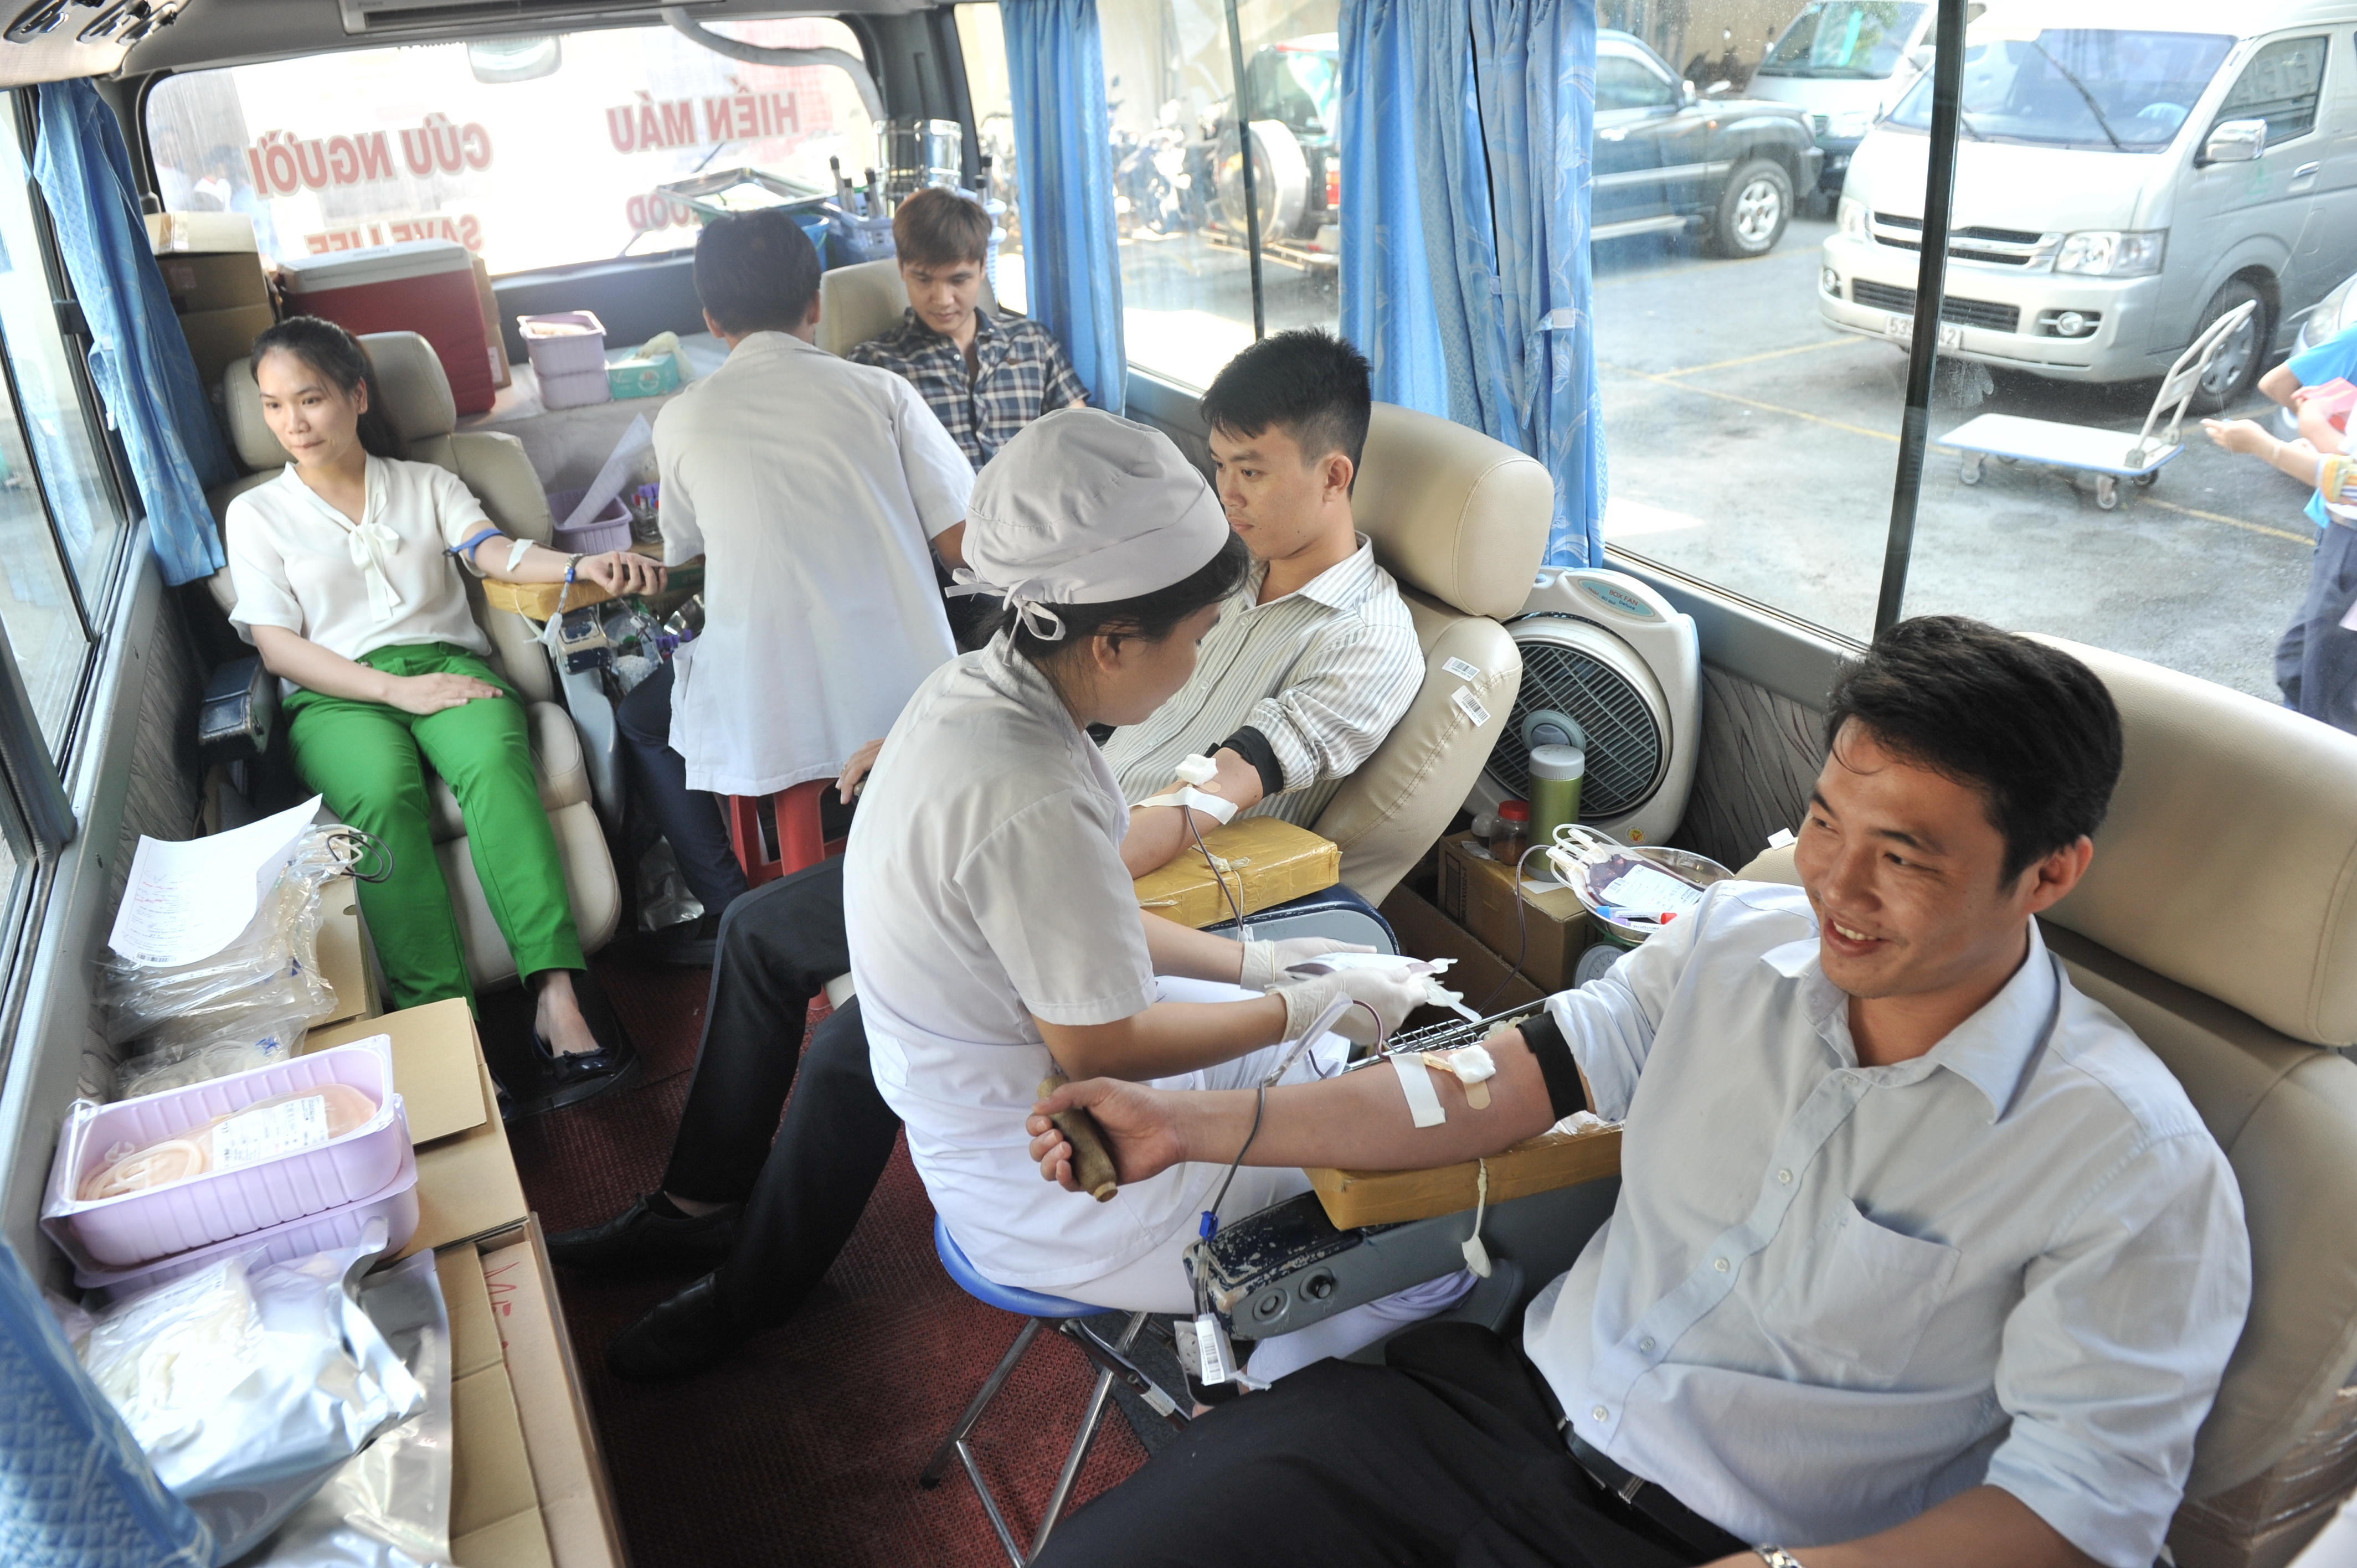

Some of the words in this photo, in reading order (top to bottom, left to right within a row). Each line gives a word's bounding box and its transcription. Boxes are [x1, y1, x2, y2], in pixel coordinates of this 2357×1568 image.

[1609, 589, 1623, 600] BOX
[1624, 596, 1638, 606] FAN
[1618, 600, 1635, 610] Deluxe
